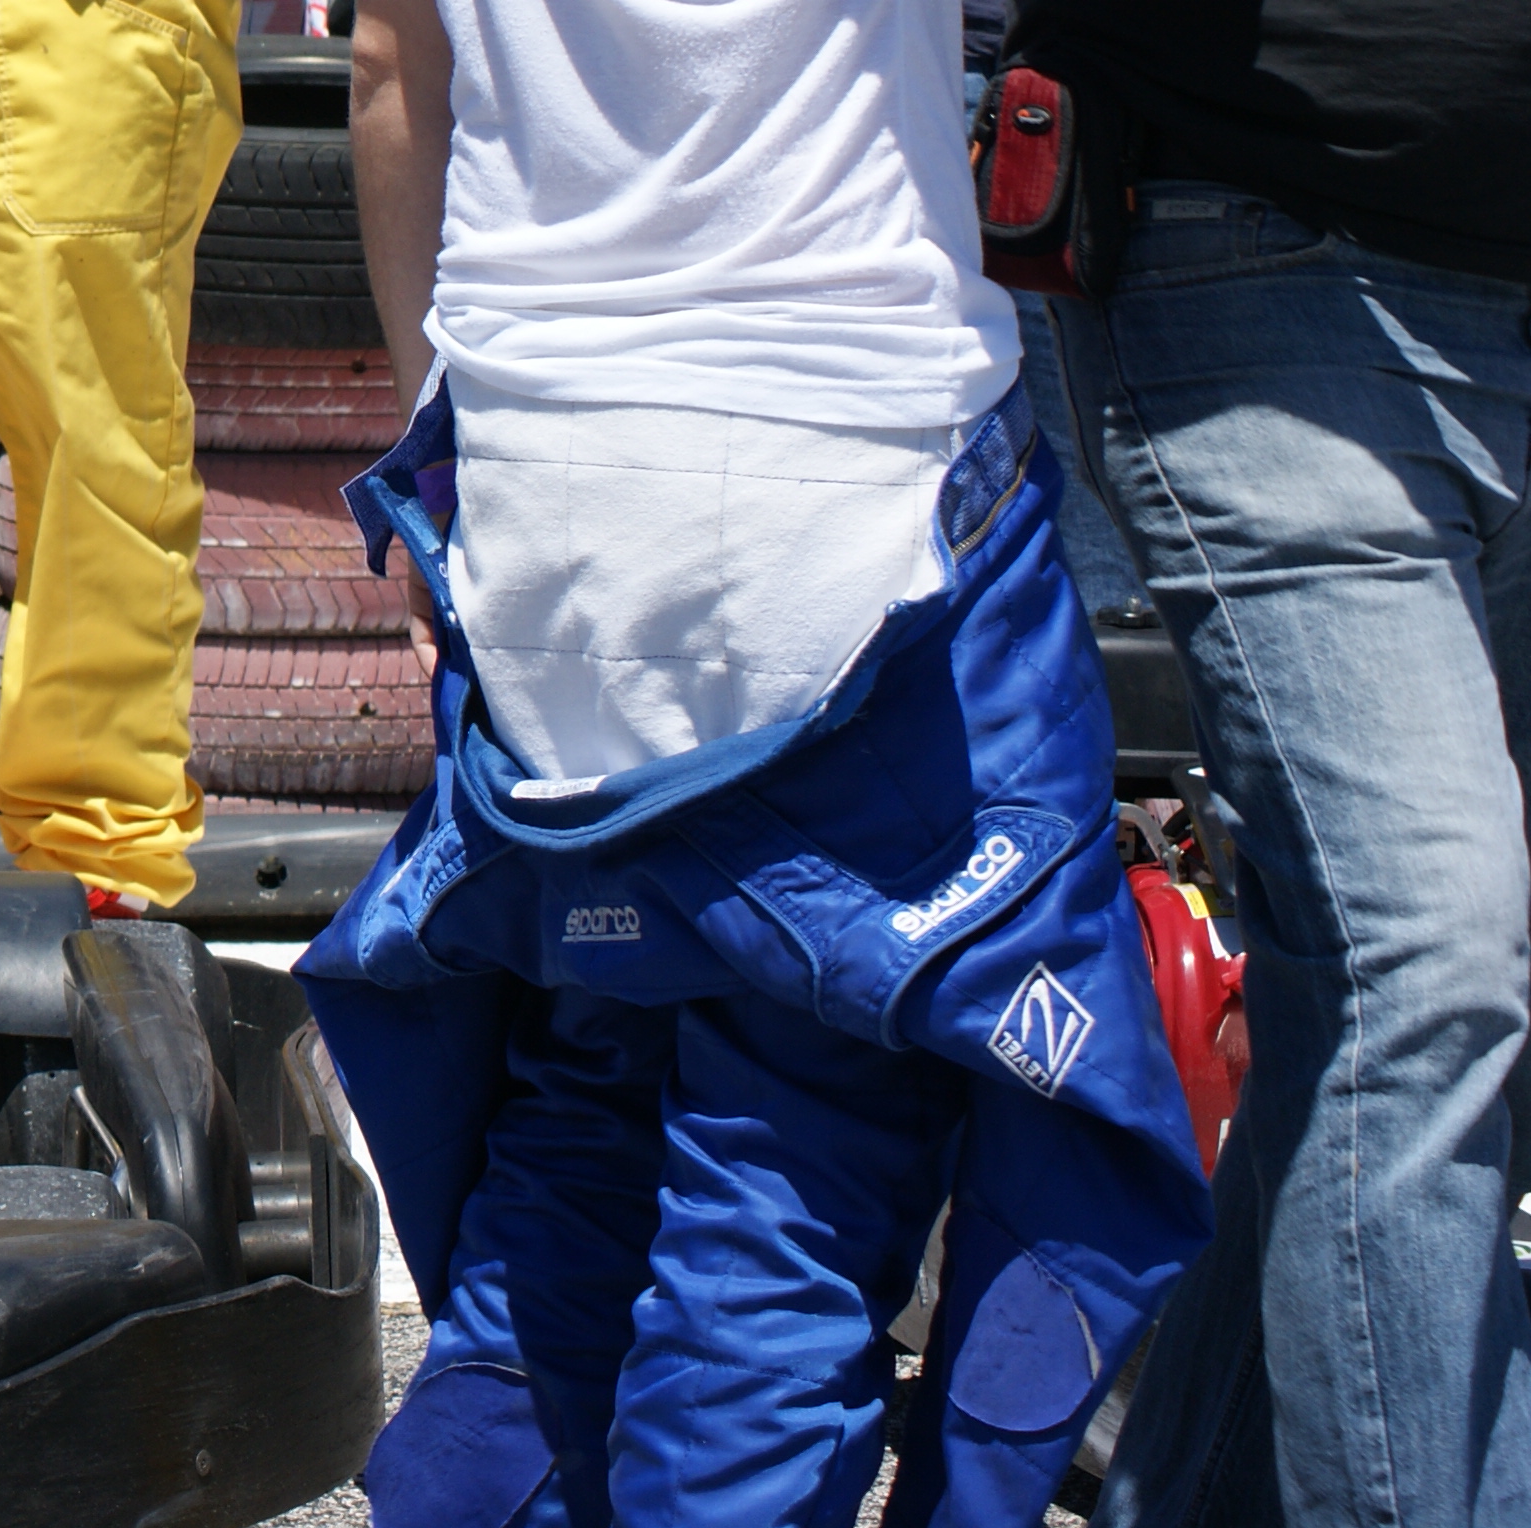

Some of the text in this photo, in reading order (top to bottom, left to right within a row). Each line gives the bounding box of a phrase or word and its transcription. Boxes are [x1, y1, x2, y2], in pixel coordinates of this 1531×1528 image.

[890, 833, 1017, 942] sparco
[566, 905, 640, 936] sparco
[997, 1030, 1051, 1088] LEVEL
